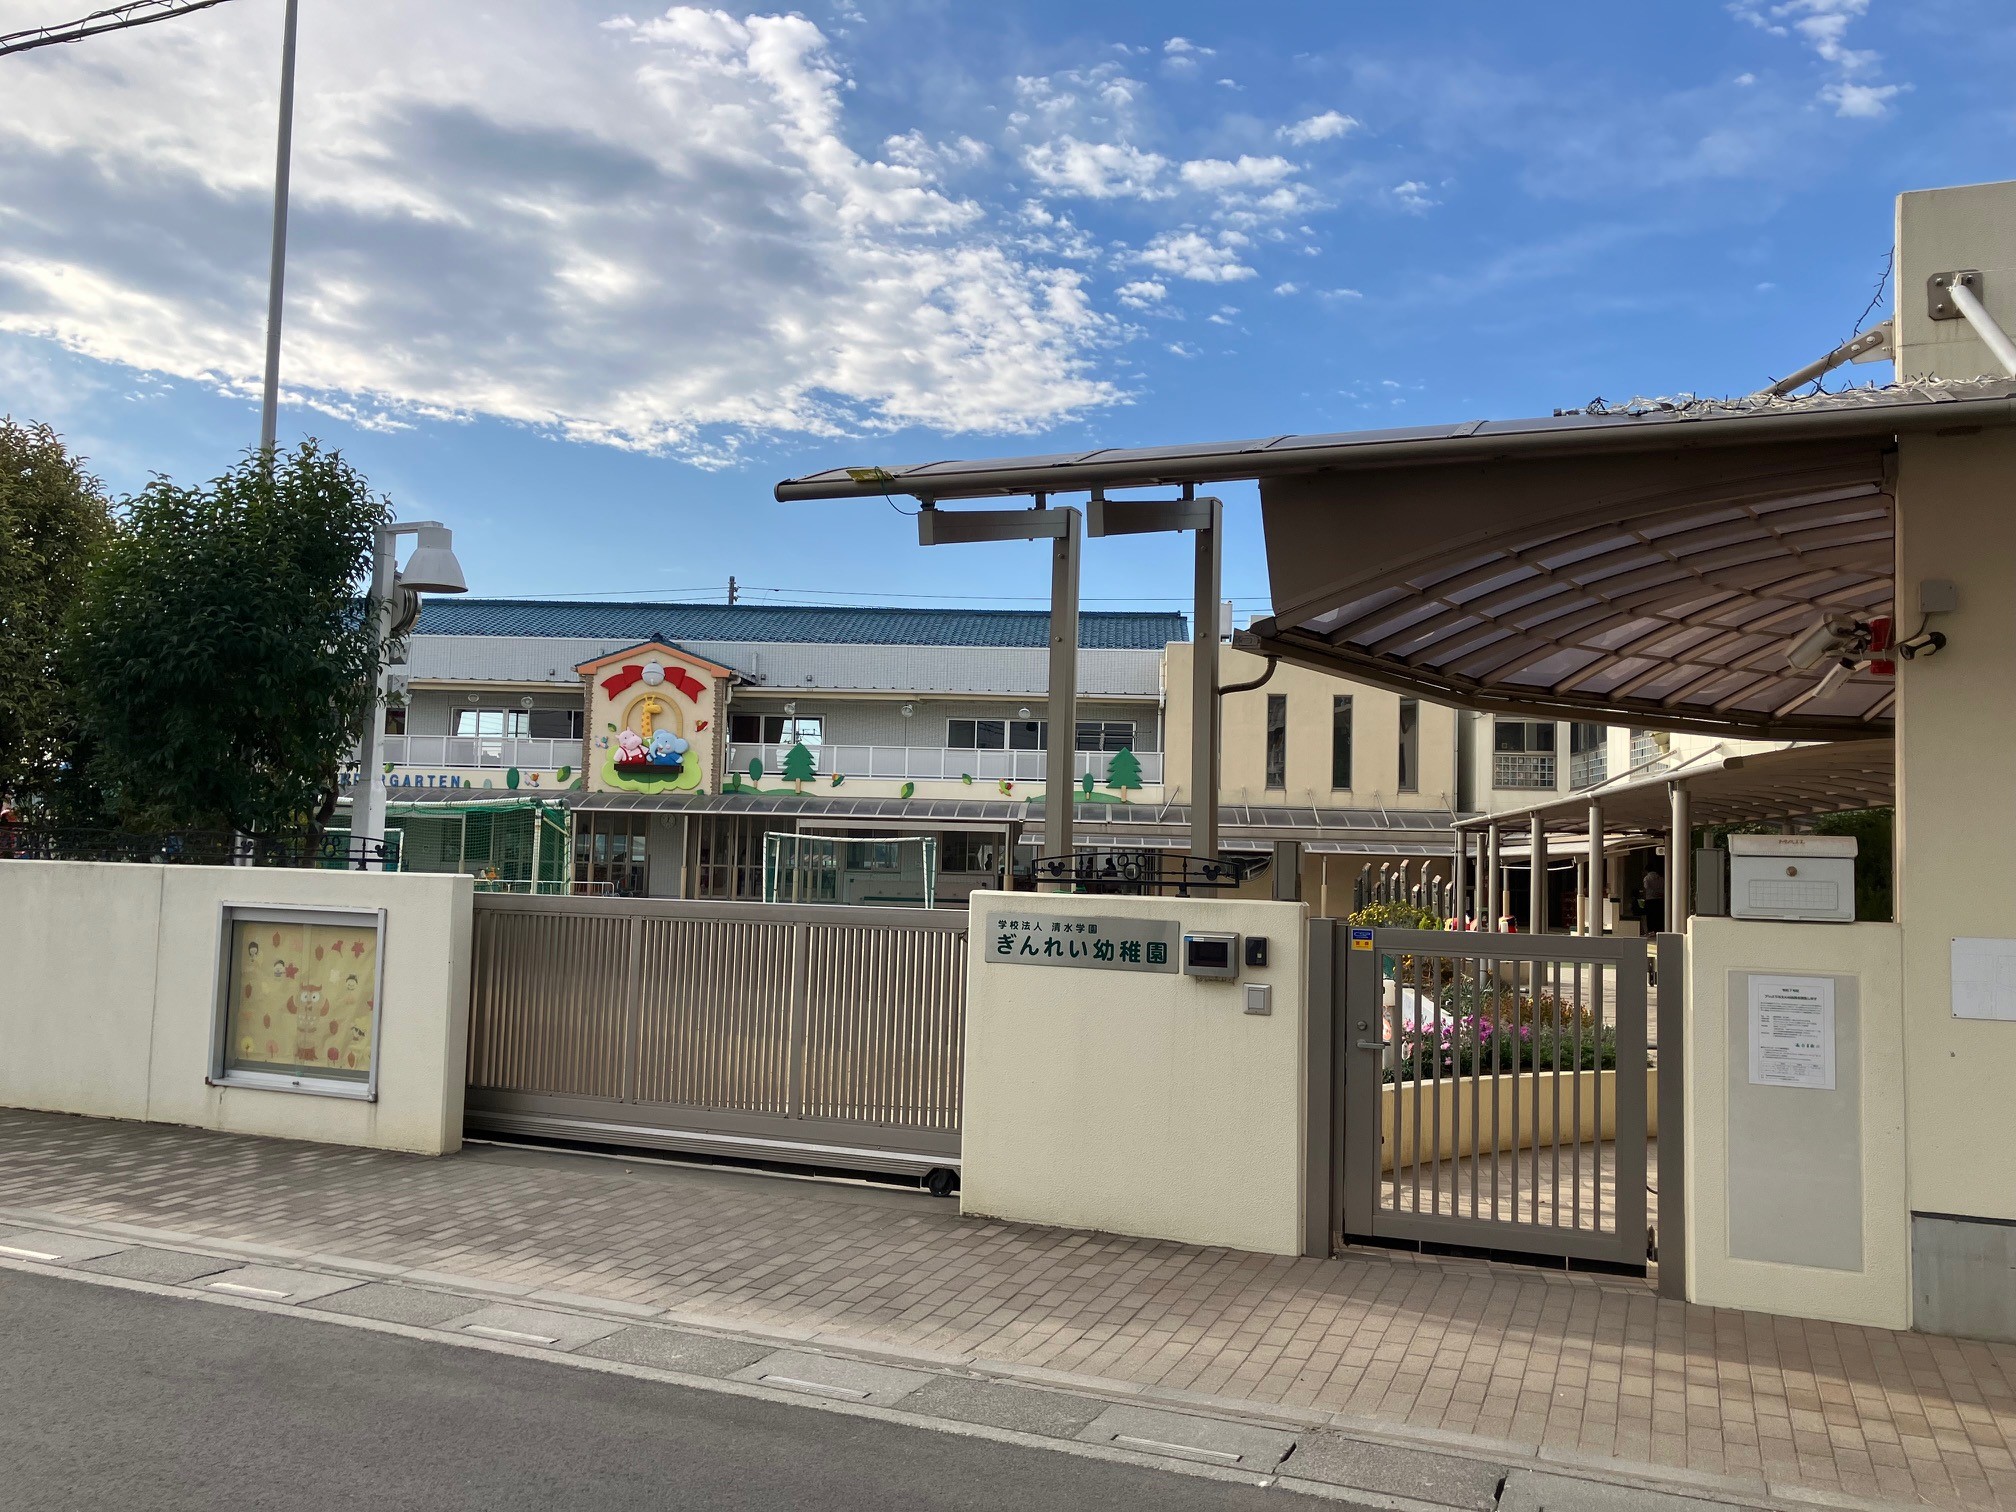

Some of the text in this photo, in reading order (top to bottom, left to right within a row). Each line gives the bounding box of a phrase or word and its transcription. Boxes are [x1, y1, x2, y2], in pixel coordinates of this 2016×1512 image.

[998, 919, 1098, 934] 学校法人 清水学園
[997, 933, 1168, 965] ぎんれい幼稚園
